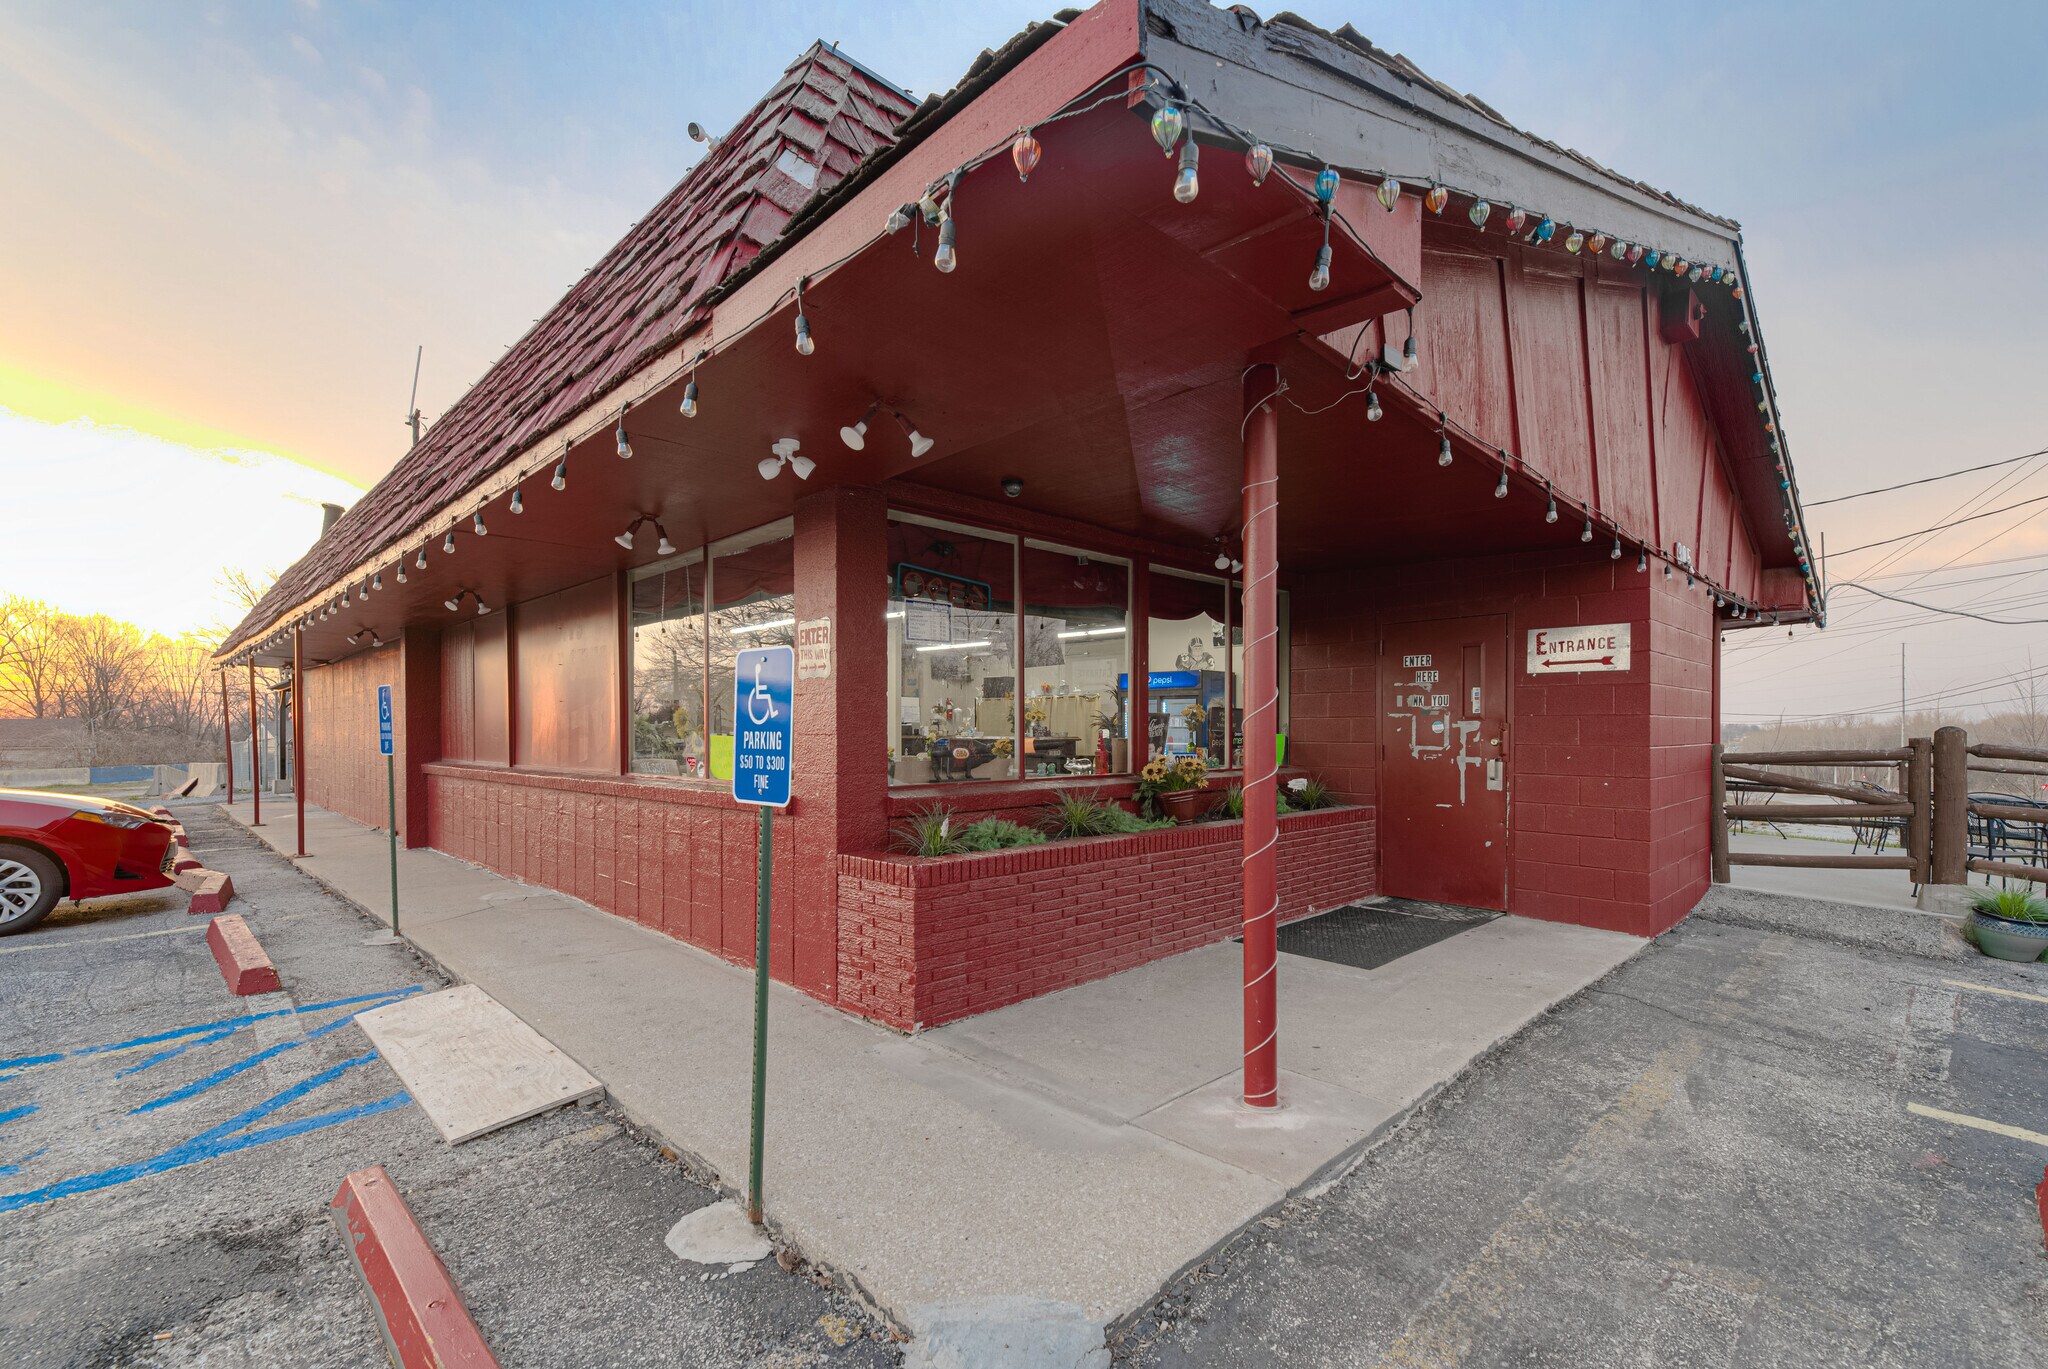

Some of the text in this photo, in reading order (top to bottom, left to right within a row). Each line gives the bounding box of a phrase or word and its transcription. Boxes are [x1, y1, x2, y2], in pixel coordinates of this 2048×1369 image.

[800, 626, 829, 646] ENTER
[1535, 631, 1617, 656] ENTRANCE
[800, 648, 829, 660] THIS WAY
[1404, 655, 1431, 667] ENTER
[1152, 675, 1173, 685] pepsi
[1416, 671, 1438, 682] HERE
[1432, 695, 1449, 706] YOU
[743, 730, 782, 750] PARKING
[739, 754, 786, 771] $50 TO $300
[753, 774, 769, 789] FINE
